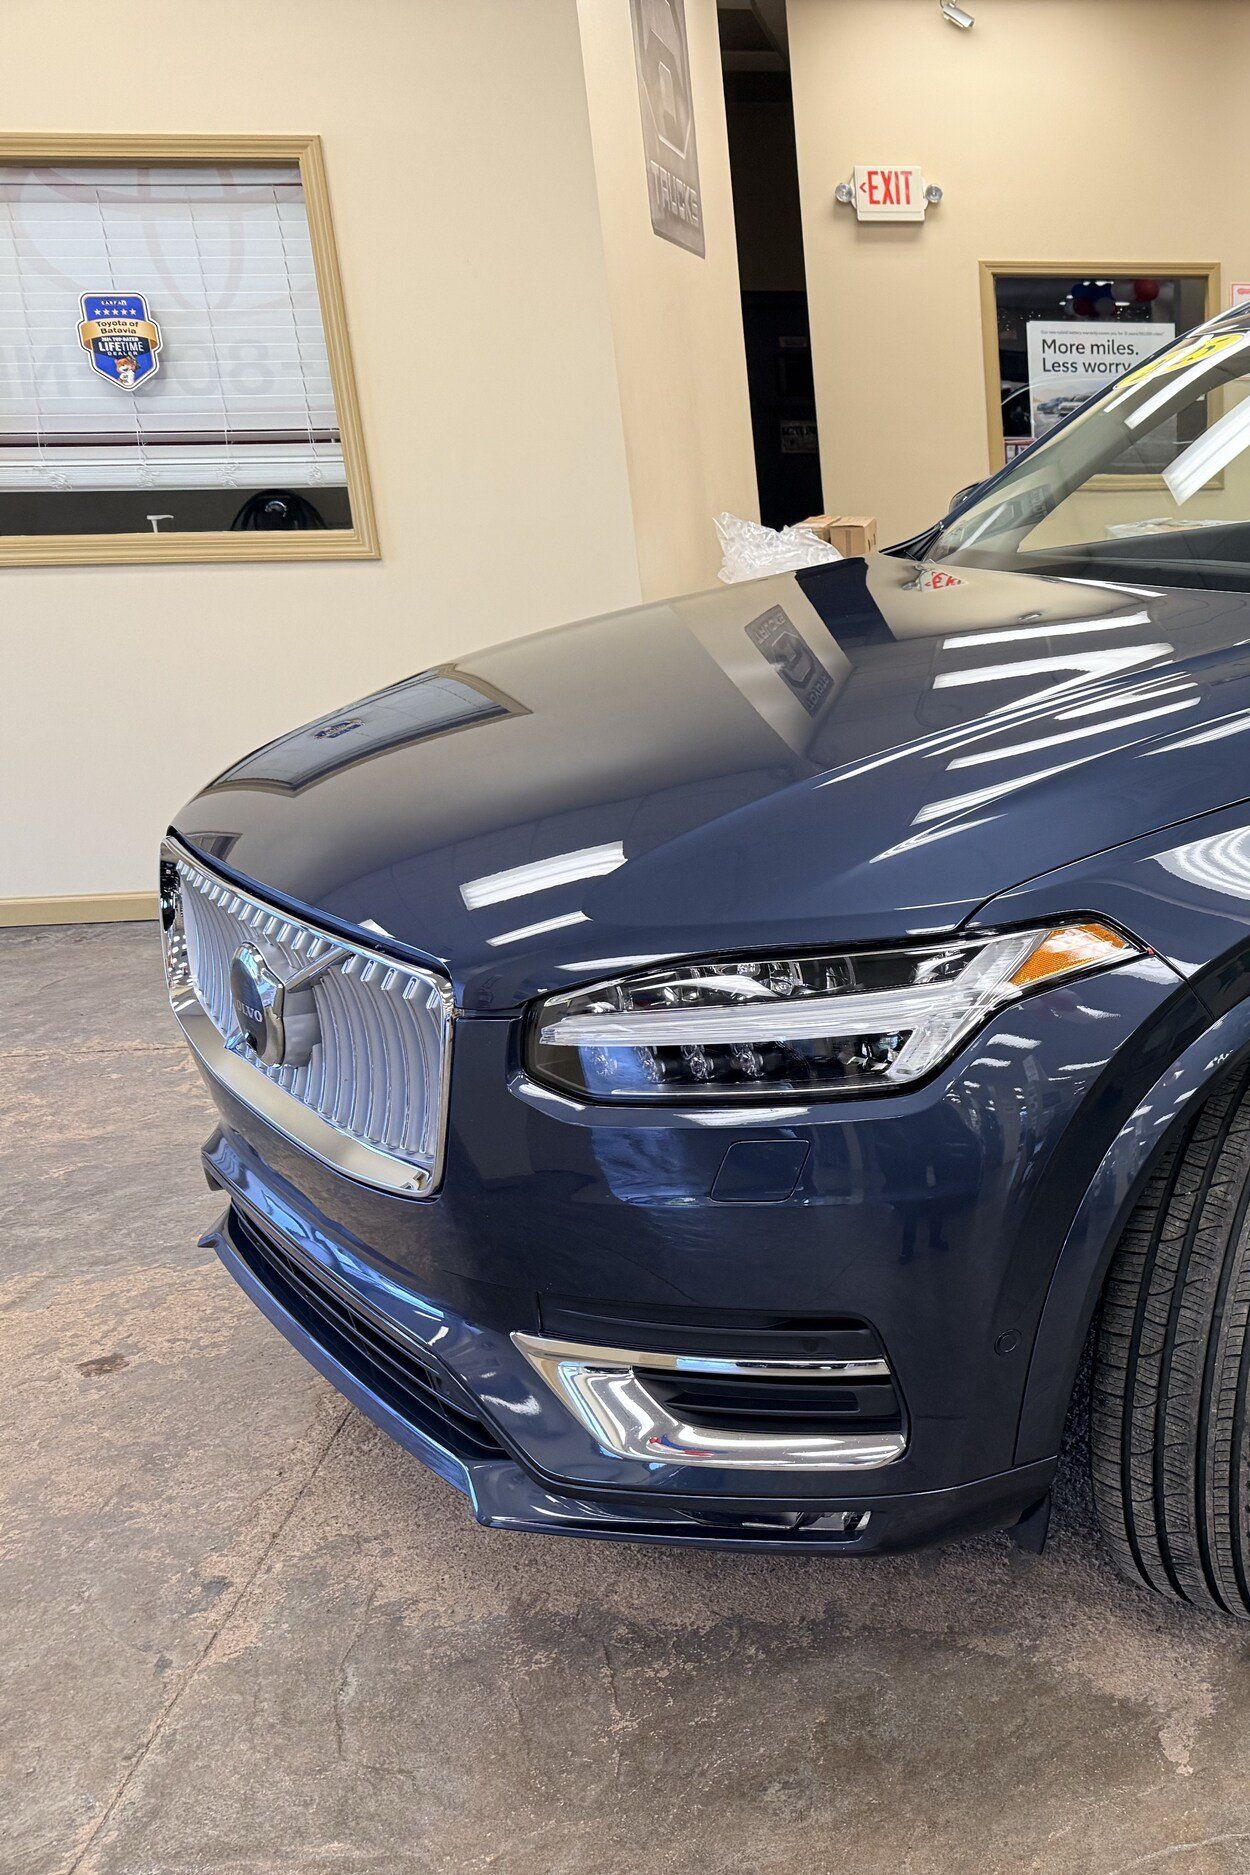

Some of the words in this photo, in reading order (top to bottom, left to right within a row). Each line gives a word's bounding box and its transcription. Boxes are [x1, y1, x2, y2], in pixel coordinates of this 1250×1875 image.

[867, 170, 913, 205] EXIT
[96, 320, 127, 328] Toyota
[100, 327, 137, 335] Batavia
[98, 341, 144, 352] LIFETIME
[1042, 339, 1085, 355] More
[1090, 339, 1139, 356] miles.
[1042, 357, 1078, 373] Less
